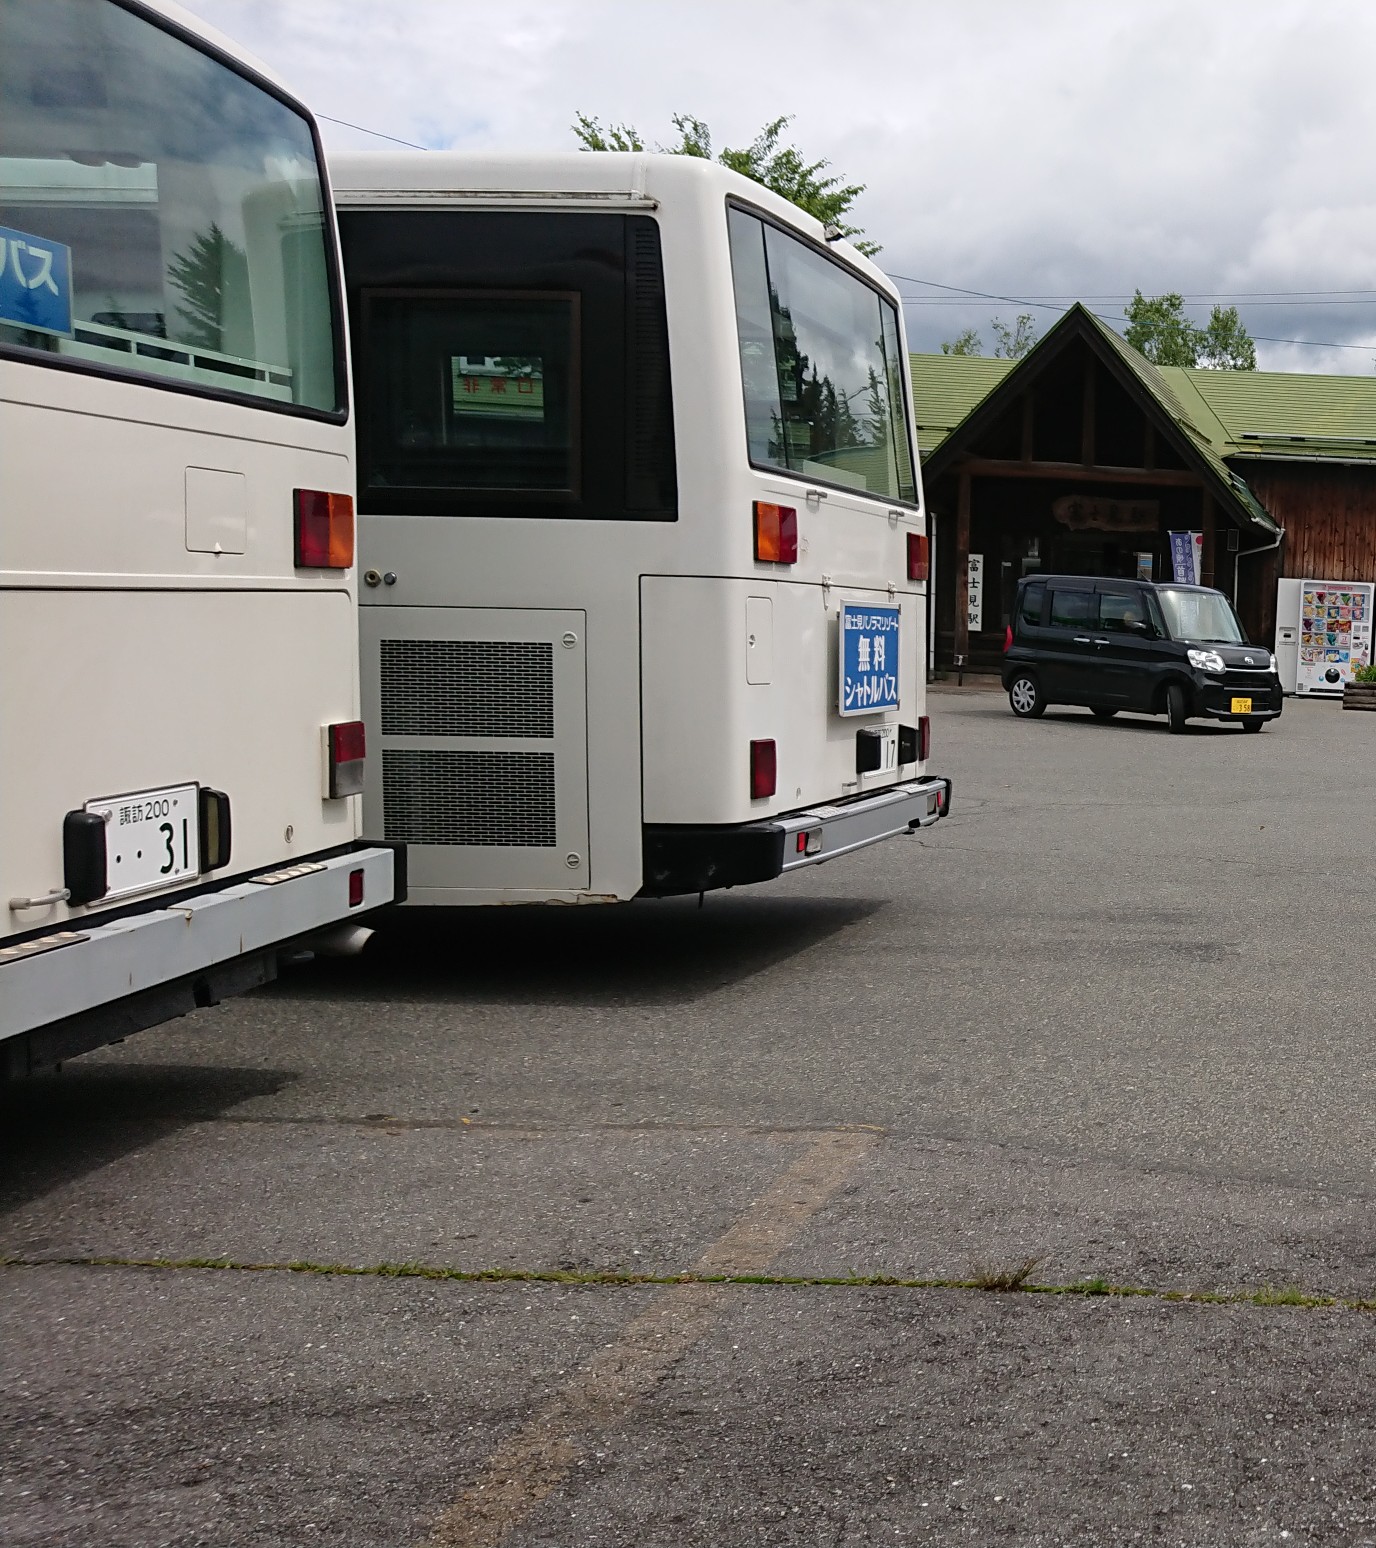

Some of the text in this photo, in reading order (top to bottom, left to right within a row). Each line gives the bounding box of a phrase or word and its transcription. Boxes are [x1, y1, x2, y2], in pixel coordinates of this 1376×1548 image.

[464, 376, 534, 393] 非常口
[968, 558, 981, 625] 富士見駅
[845, 614, 899, 631] 富士見パノラマリゾート
[858, 634, 886, 672] 無料
[845, 672, 897, 706] シャトルバス
[886, 739, 896, 769] 17
